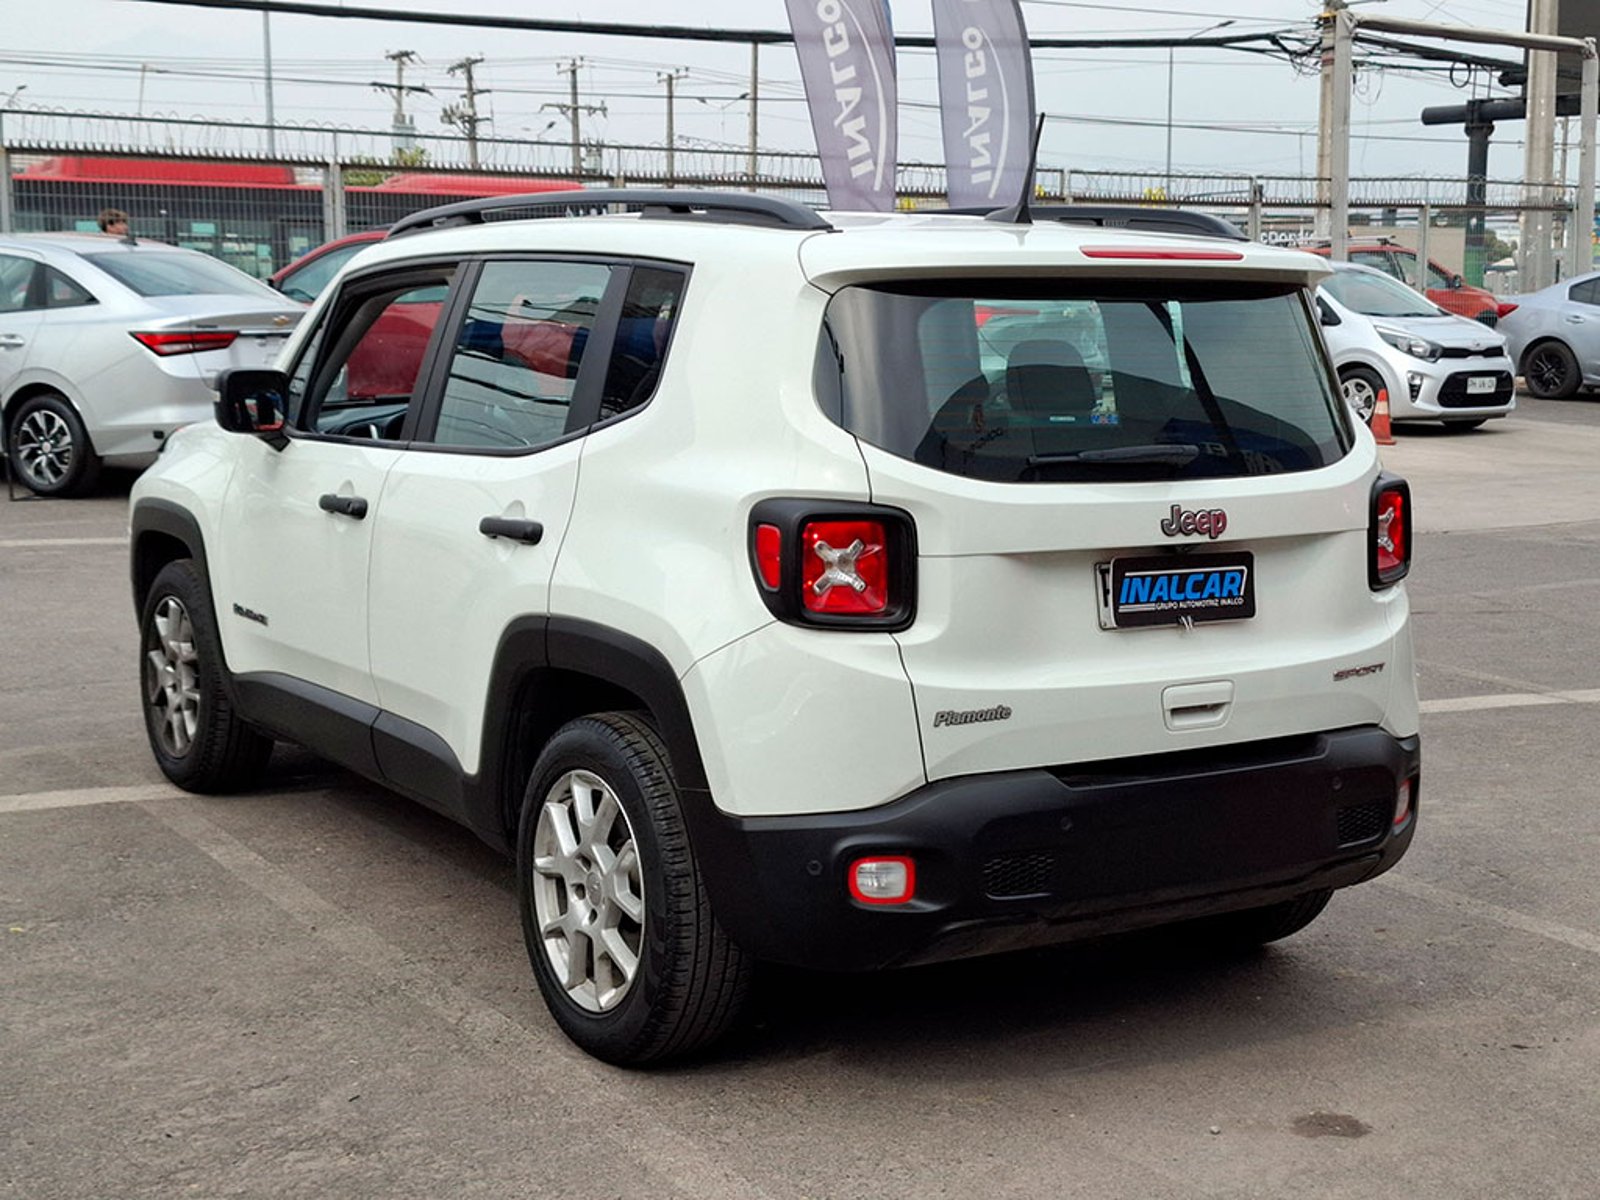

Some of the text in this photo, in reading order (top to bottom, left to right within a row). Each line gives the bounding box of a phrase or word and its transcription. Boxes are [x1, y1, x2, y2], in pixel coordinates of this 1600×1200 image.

[1161, 505, 1227, 539] Jeep
[1120, 571, 1242, 604] INALCAR
[1156, 602, 1178, 610] GRUPO
